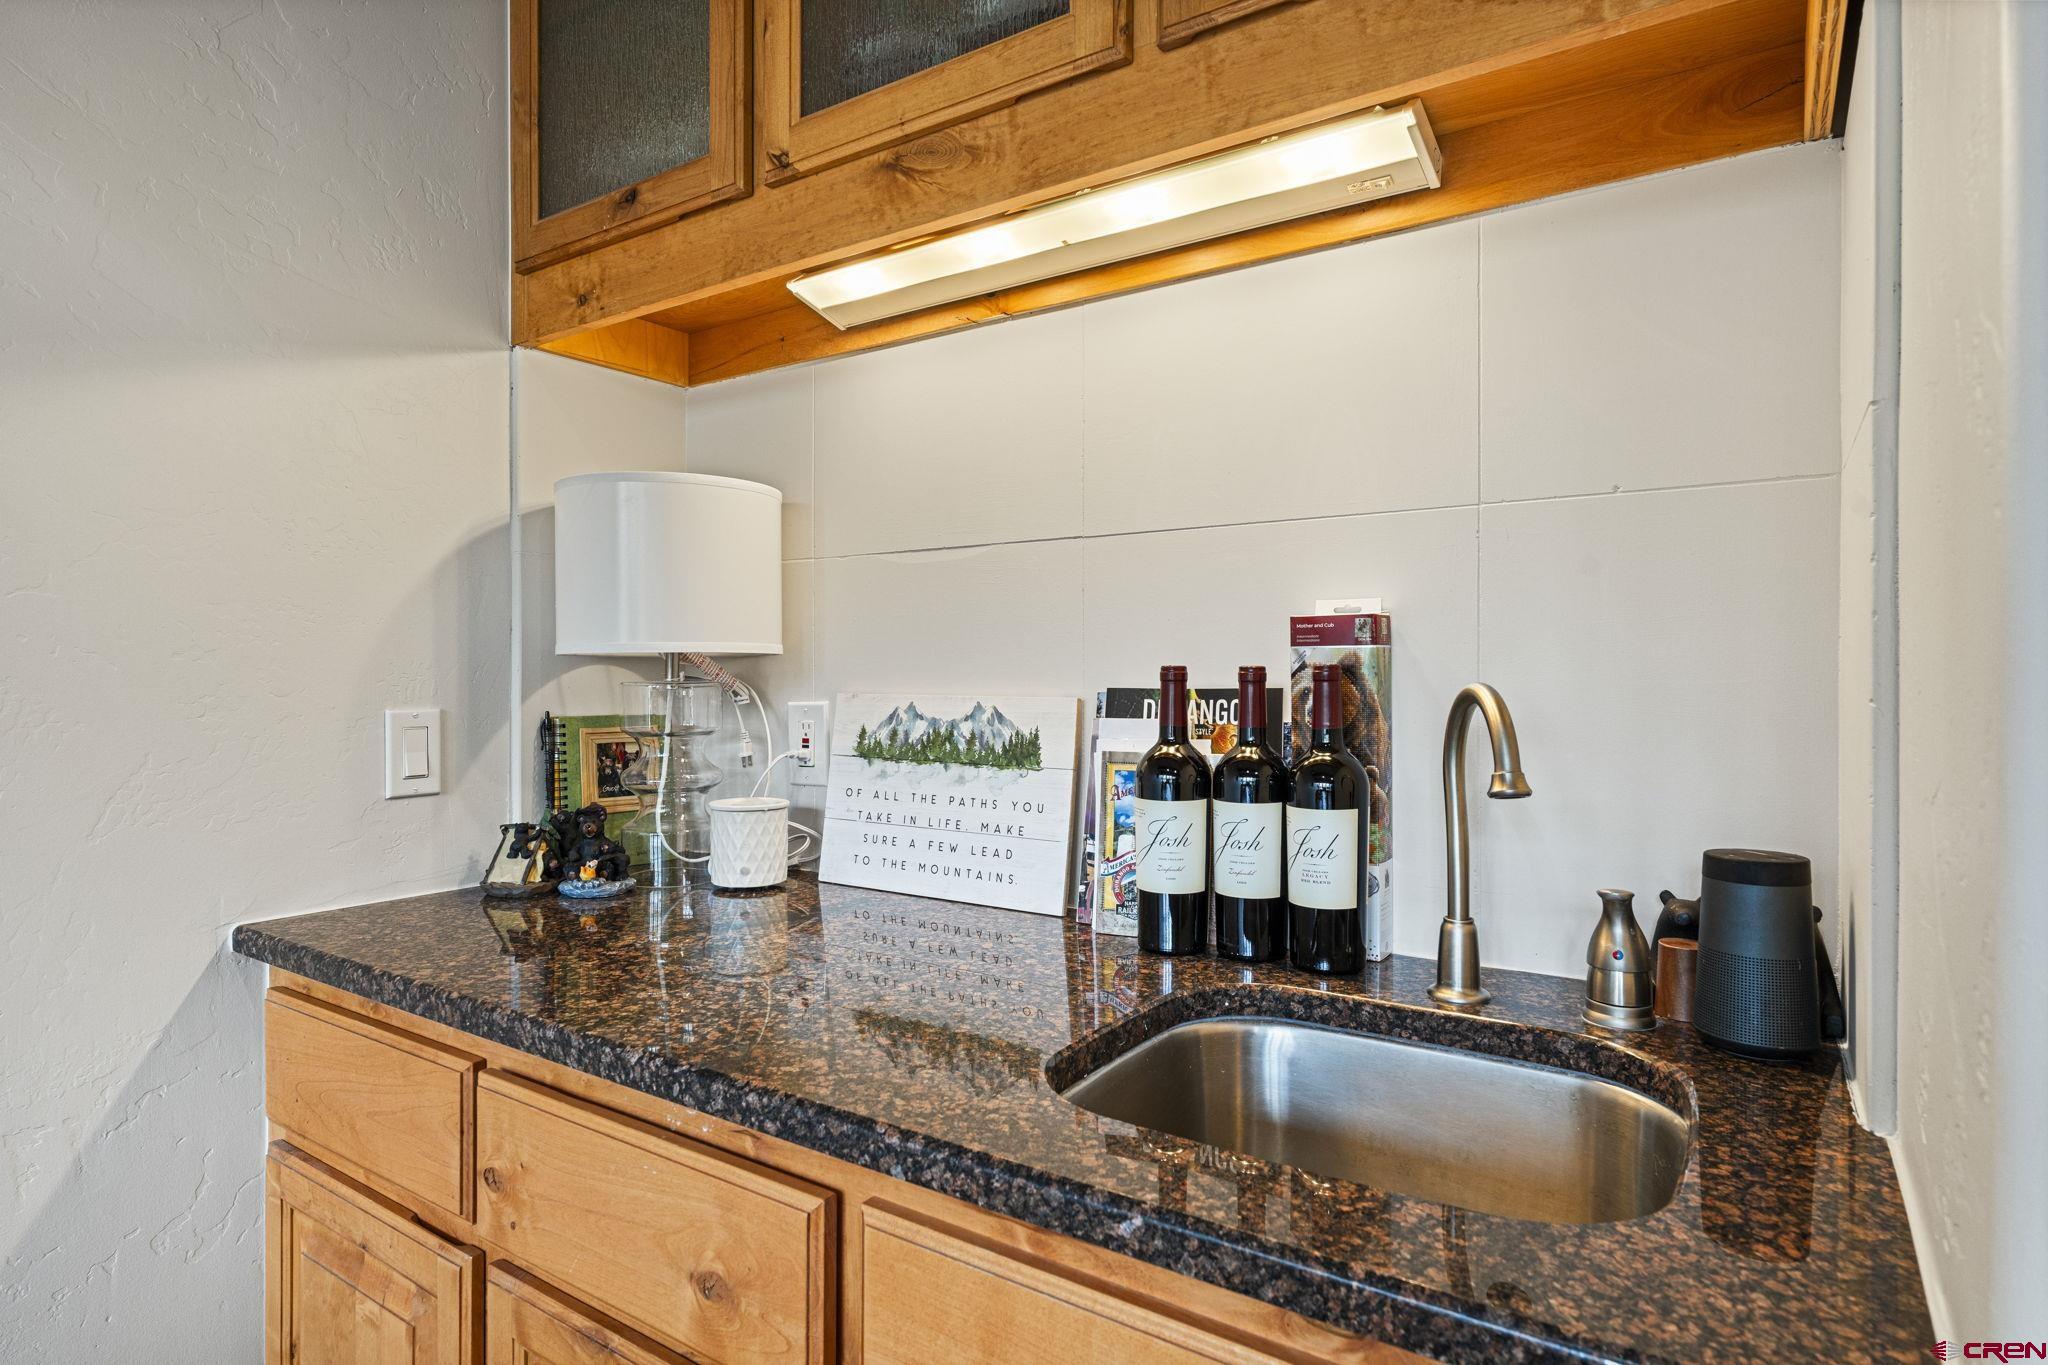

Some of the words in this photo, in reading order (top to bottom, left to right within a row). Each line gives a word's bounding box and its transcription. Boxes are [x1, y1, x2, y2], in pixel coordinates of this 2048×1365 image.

[1143, 699, 1239, 725] DANGO
[845, 788, 863, 798] OF
[873, 790, 900, 801] ALL
[912, 793, 936, 805] THE
[949, 796, 999, 810] PATHS
[1011, 801, 1045, 814] YOU
[1110, 785, 1136, 801] AME
[857, 810, 892, 823] TAKE
[903, 815, 916, 825] IN
[981, 823, 1025, 837] MAKE
[864, 834, 897, 846] SURE
[909, 839, 916, 849] A
[928, 841, 959, 854] FEW
[971, 846, 1013, 860] LEAD
[1136, 816, 1194, 866] Josh
[1215, 818, 1266, 866] Josh
[1289, 826, 1339, 872] Josh
[854, 854, 870, 866] TO
[882, 857, 907, 871] THE
